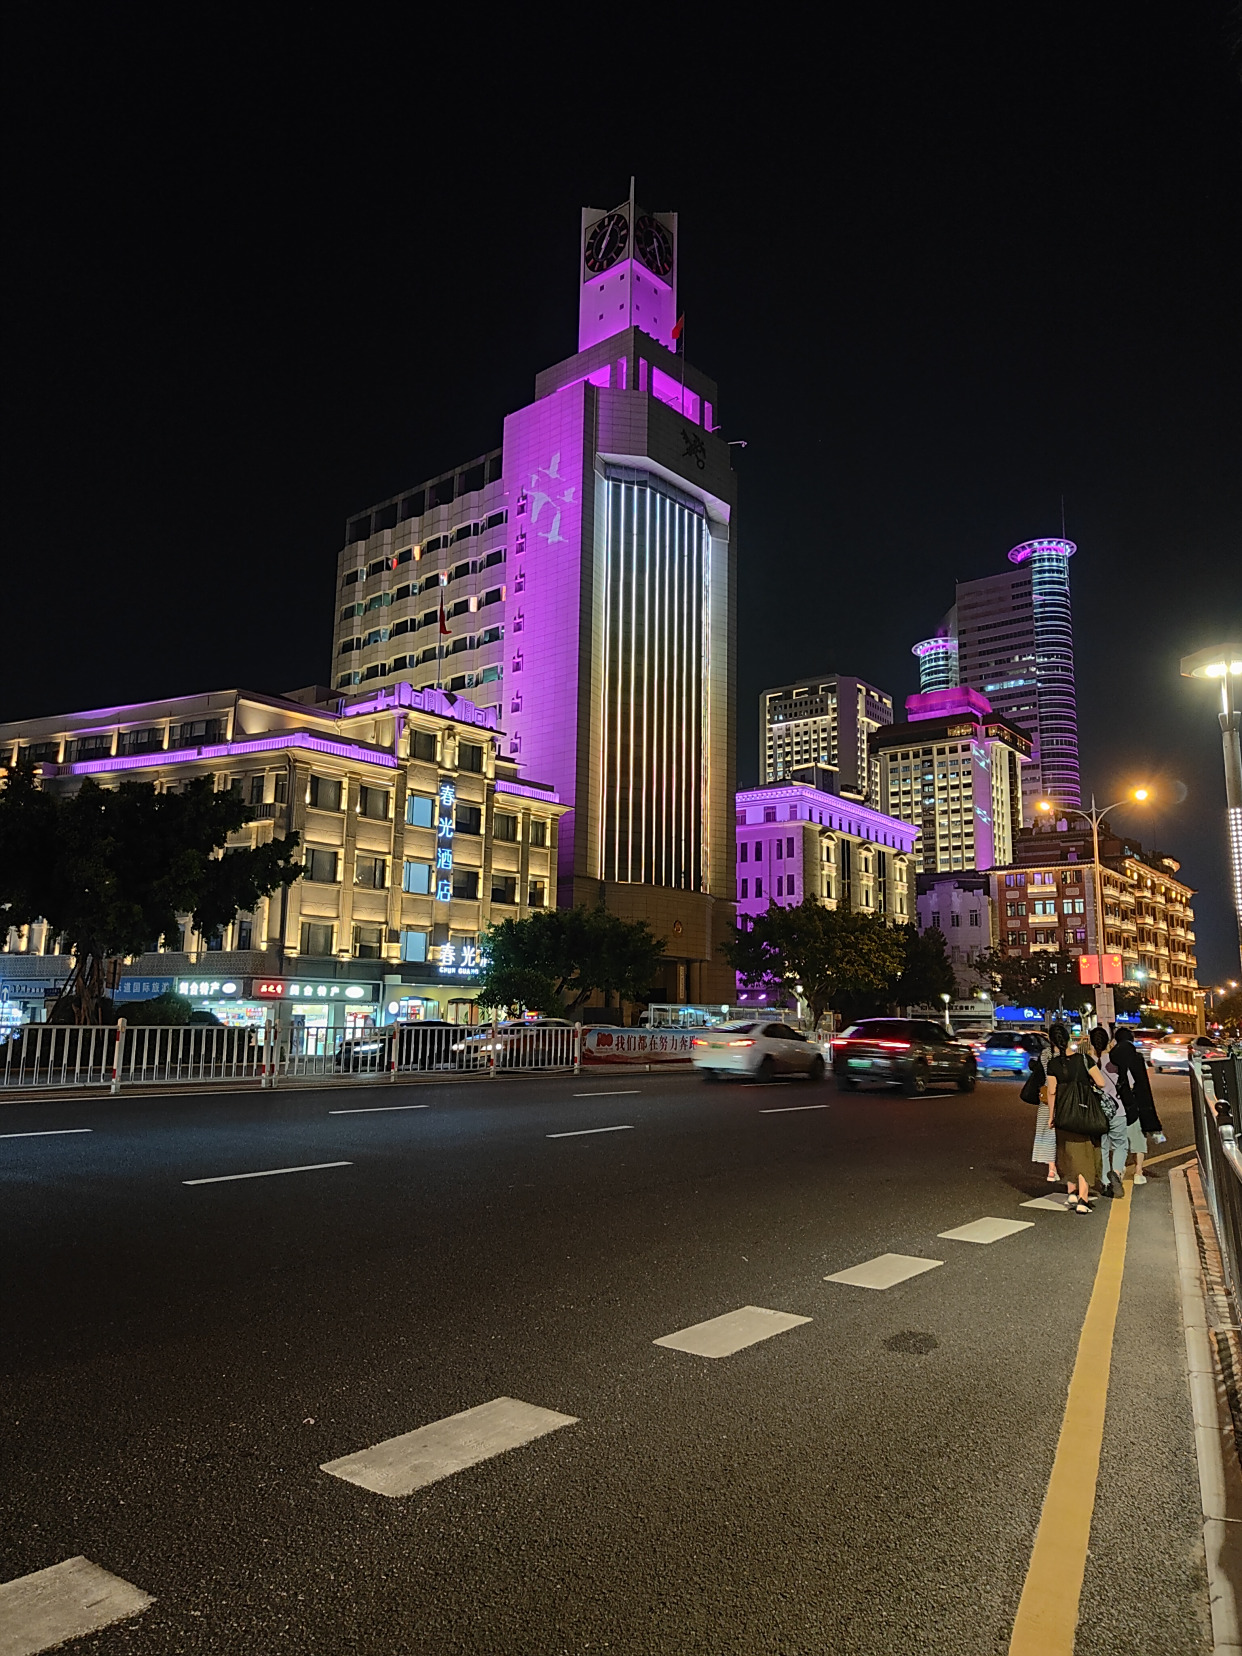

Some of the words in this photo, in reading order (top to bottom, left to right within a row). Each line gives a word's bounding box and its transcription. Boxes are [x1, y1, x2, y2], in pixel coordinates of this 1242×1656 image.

[436, 785, 456, 902] 春光酒店
[458, 967, 479, 975] GUANG
